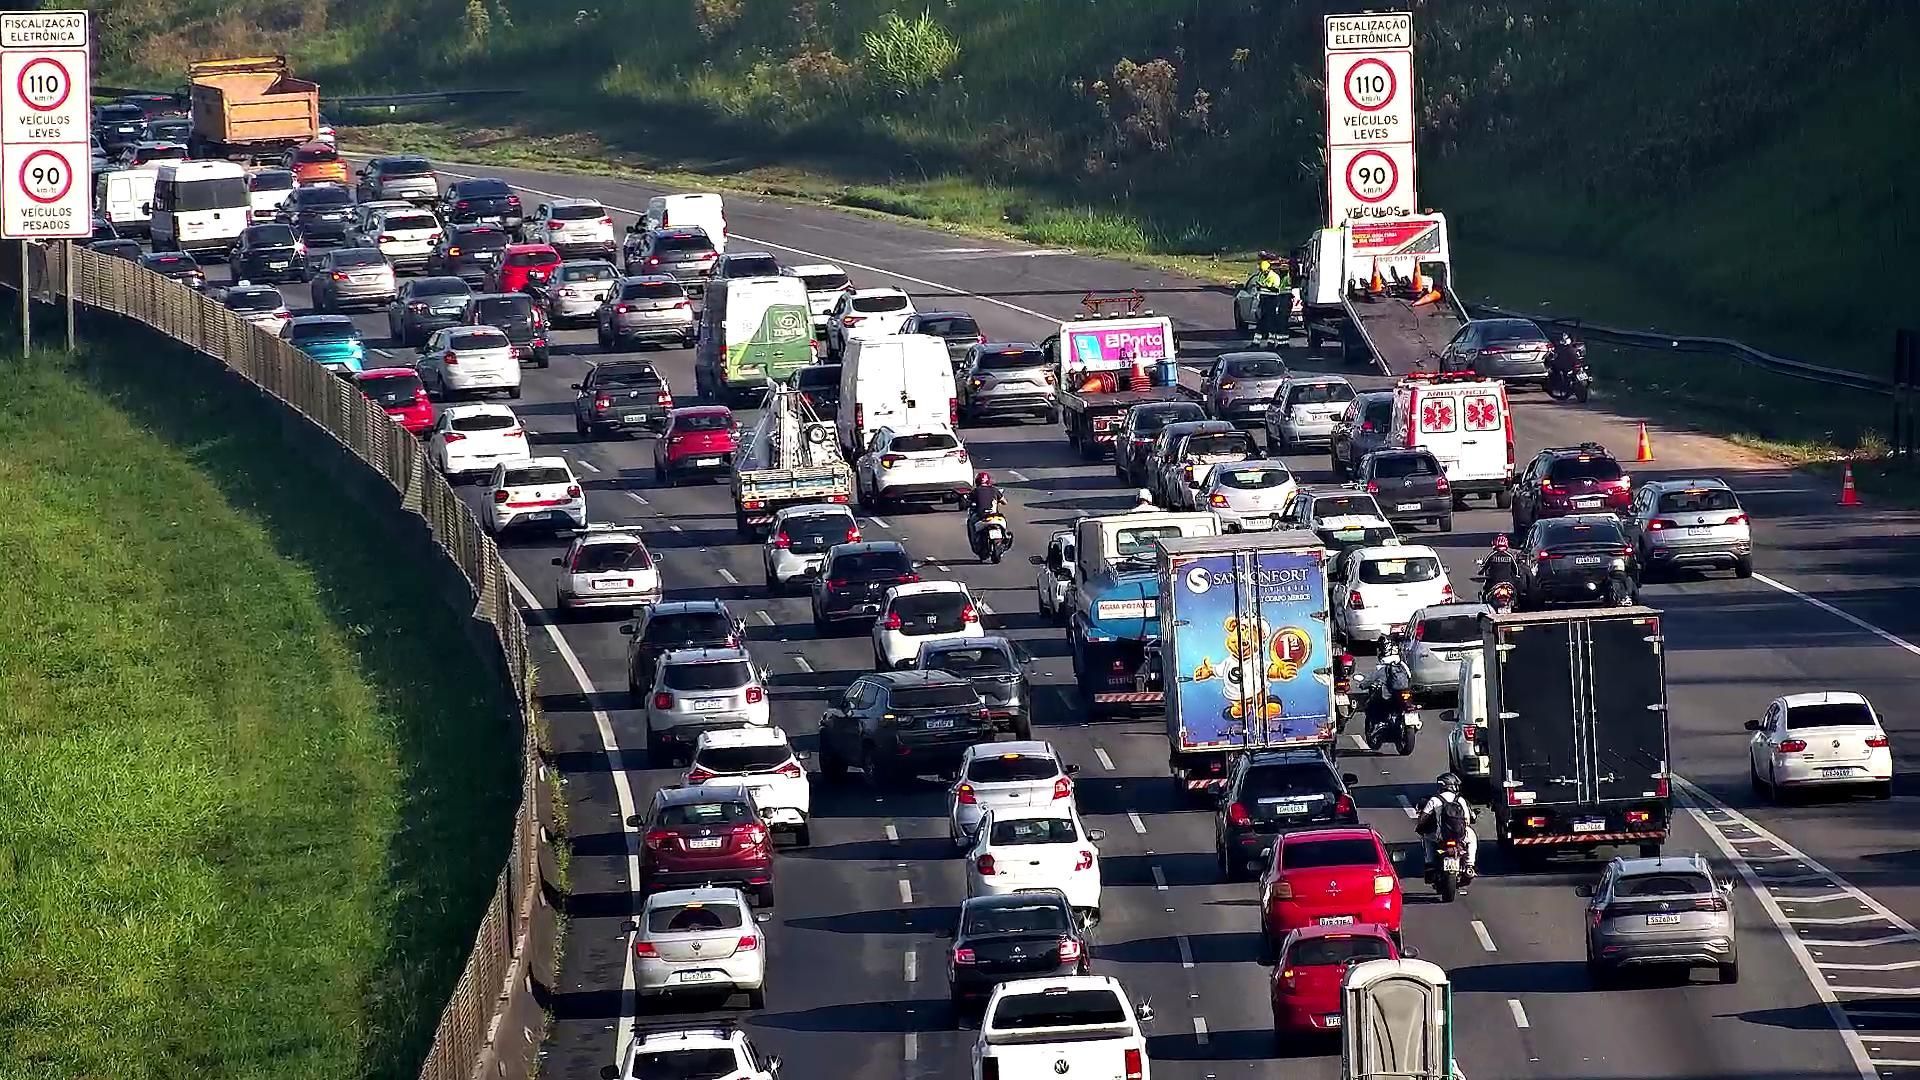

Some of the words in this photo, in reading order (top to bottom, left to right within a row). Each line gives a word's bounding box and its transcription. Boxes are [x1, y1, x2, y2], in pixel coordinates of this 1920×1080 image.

[5, 17, 80, 28] FISCALIZAÇÃO
[1329, 18, 1407, 31] FISCALIZAÇÃO
[11, 29, 75, 41] ELETRÔNICA
[1335, 31, 1401, 44] ELETRÔNICA
[30, 75, 58, 93] 110
[1356, 75, 1384, 94] 110
[20, 112, 70, 125] VEÍCULOS
[1344, 112, 1399, 126] VEÍCULOS
[28, 128, 61, 138] LEVES
[1354, 129, 1389, 140] LEVES
[32, 167, 59, 185] 90
[1358, 167, 1386, 184] 90
[21, 204, 72, 217] VEÍCULOS
[23, 221, 70, 230] PESADOS
[1120, 332, 1164, 346] Porto
